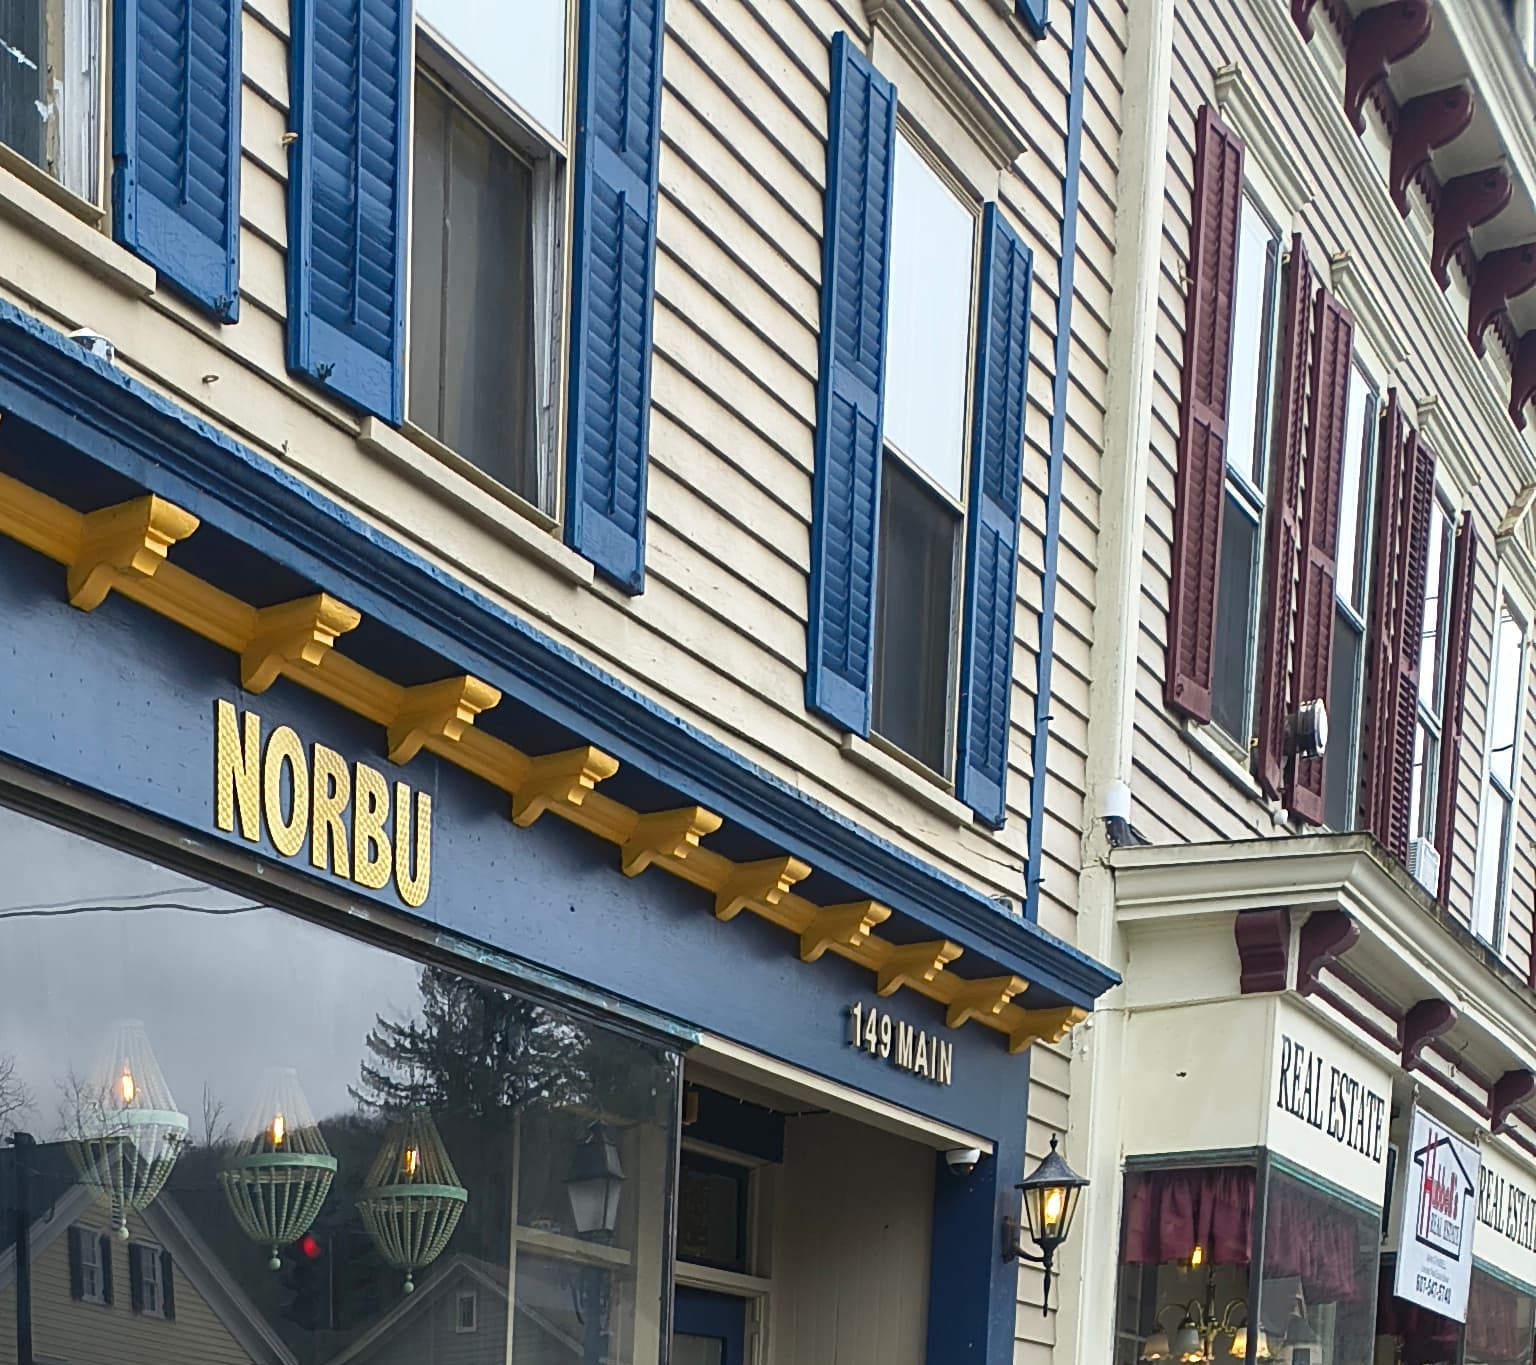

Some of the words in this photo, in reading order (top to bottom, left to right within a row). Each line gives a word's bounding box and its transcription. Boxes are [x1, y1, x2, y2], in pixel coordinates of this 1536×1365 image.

[217, 698, 432, 908] NORBU
[851, 1001, 892, 1058] 149
[895, 1021, 953, 1086] MAIN
[1276, 1033, 1323, 1131] REAL
[1326, 1065, 1386, 1164] ESTATE
[1476, 1165, 1505, 1233] REAL
